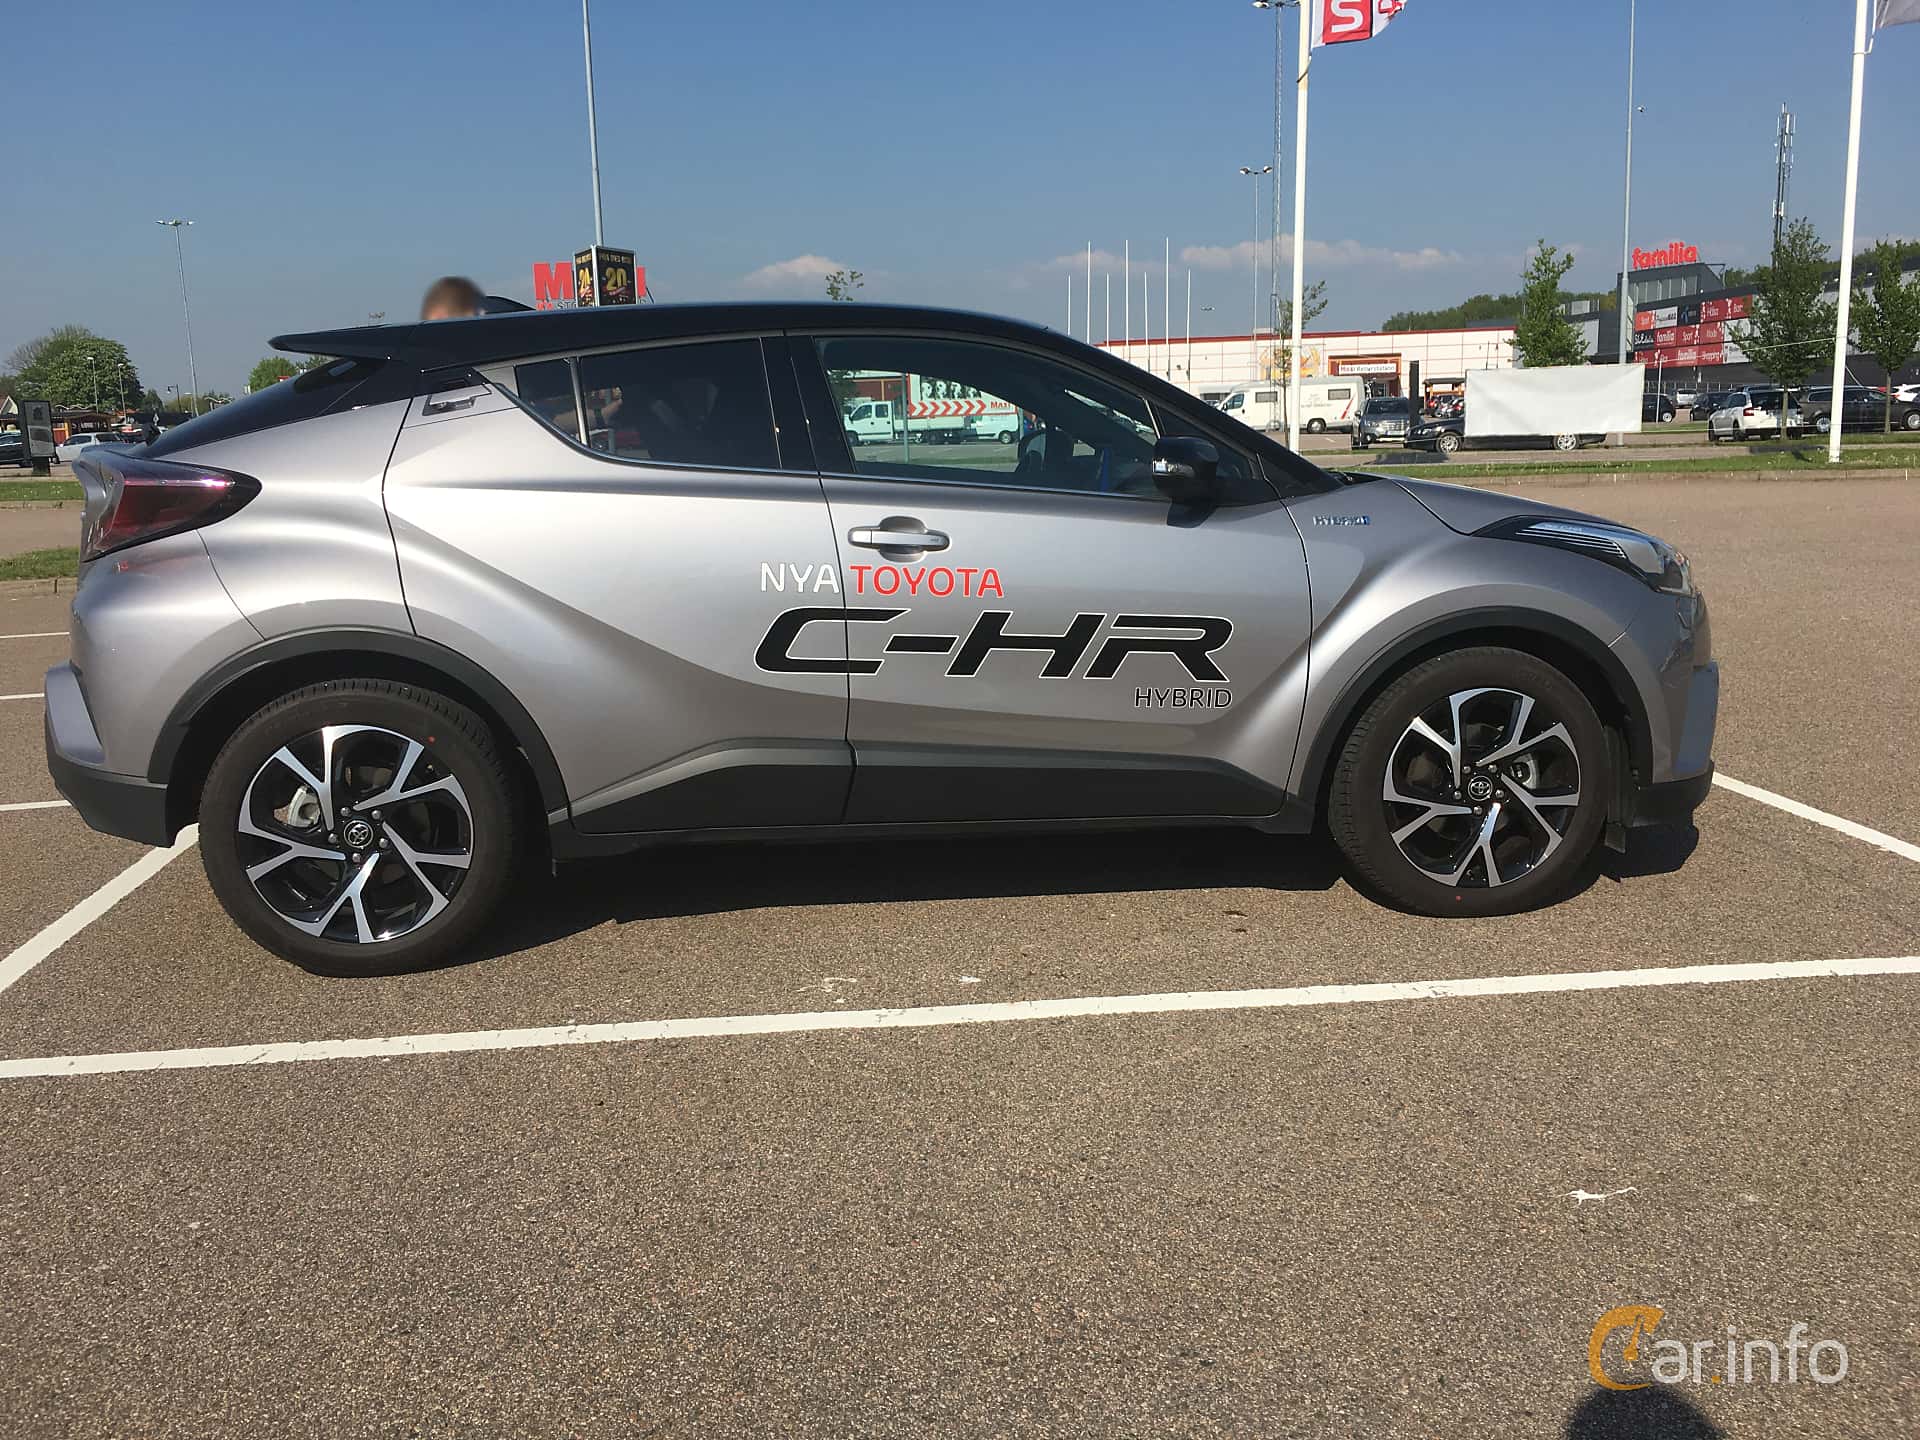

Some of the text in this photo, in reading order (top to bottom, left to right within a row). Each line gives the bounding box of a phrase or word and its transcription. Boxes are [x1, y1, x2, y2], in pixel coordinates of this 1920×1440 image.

[1632, 241, 1697, 269] familia
[760, 562, 1004, 598] NYA TOYOTA
[754, 605, 1234, 683] C-HR
[1134, 687, 1233, 710] HYBRID
